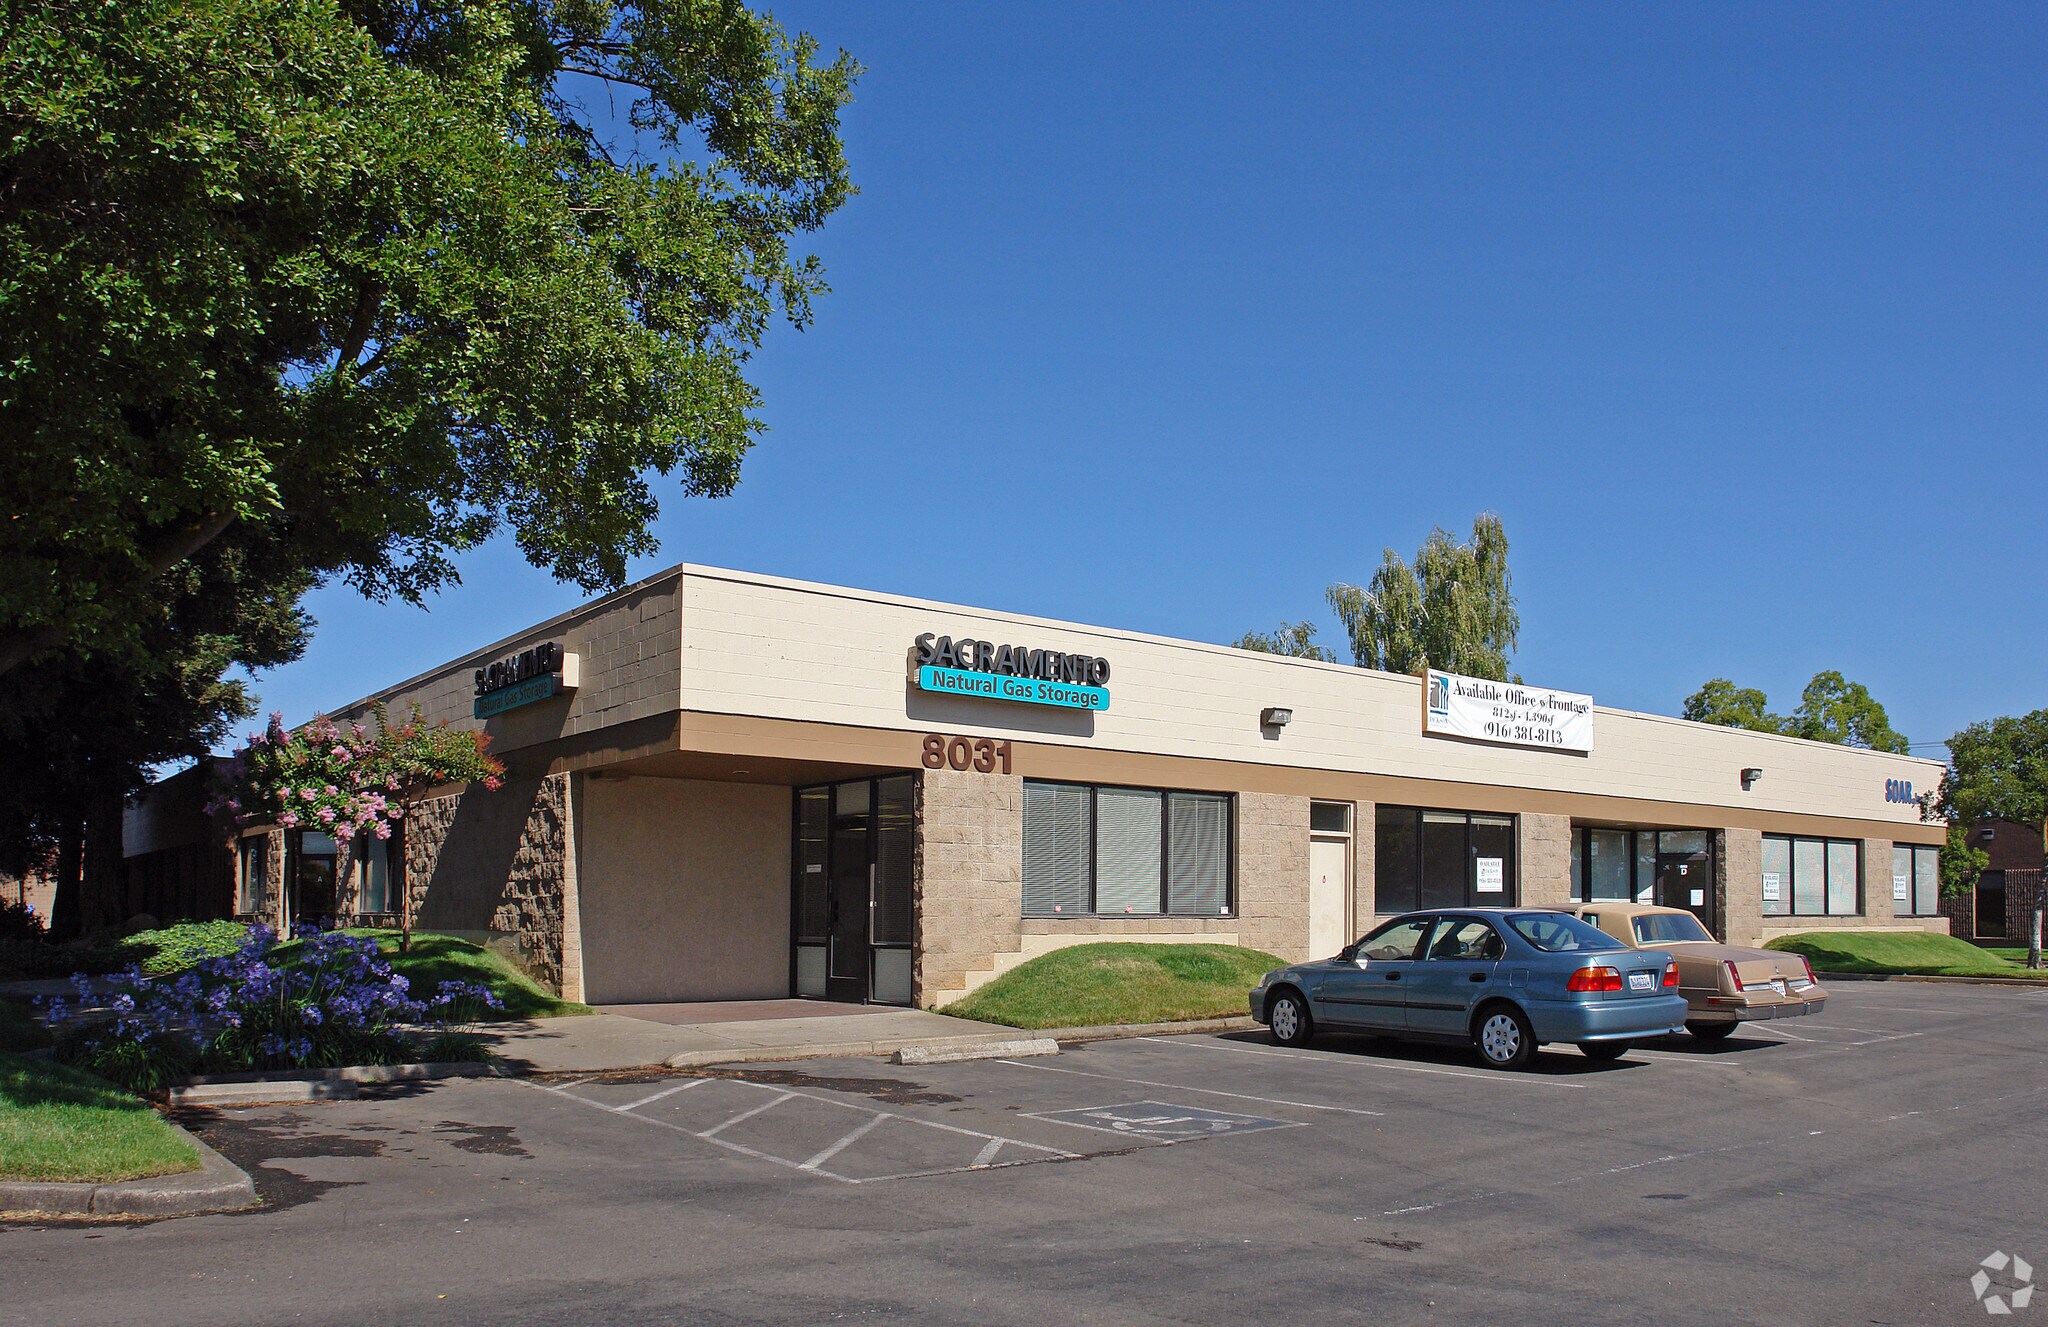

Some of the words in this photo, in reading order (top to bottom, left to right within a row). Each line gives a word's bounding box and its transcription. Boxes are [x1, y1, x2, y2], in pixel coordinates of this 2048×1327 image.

[915, 632, 1110, 685] SACRAMENTO
[505, 691, 517, 706] Gas
[520, 681, 548, 702] Storage
[933, 670, 997, 693] Natural
[1003, 679, 1033, 698] Gas
[1038, 684, 1099, 708] Storage
[1453, 680, 1502, 701] Available
[1505, 688, 1536, 707] Office
[1492, 707, 1517, 721] 812sf
[1484, 722, 1511, 739] (916)
[1514, 725, 1563, 744] 381-8113
[922, 734, 1012, 774] 8031
[1885, 778, 1912, 804] SOAR
